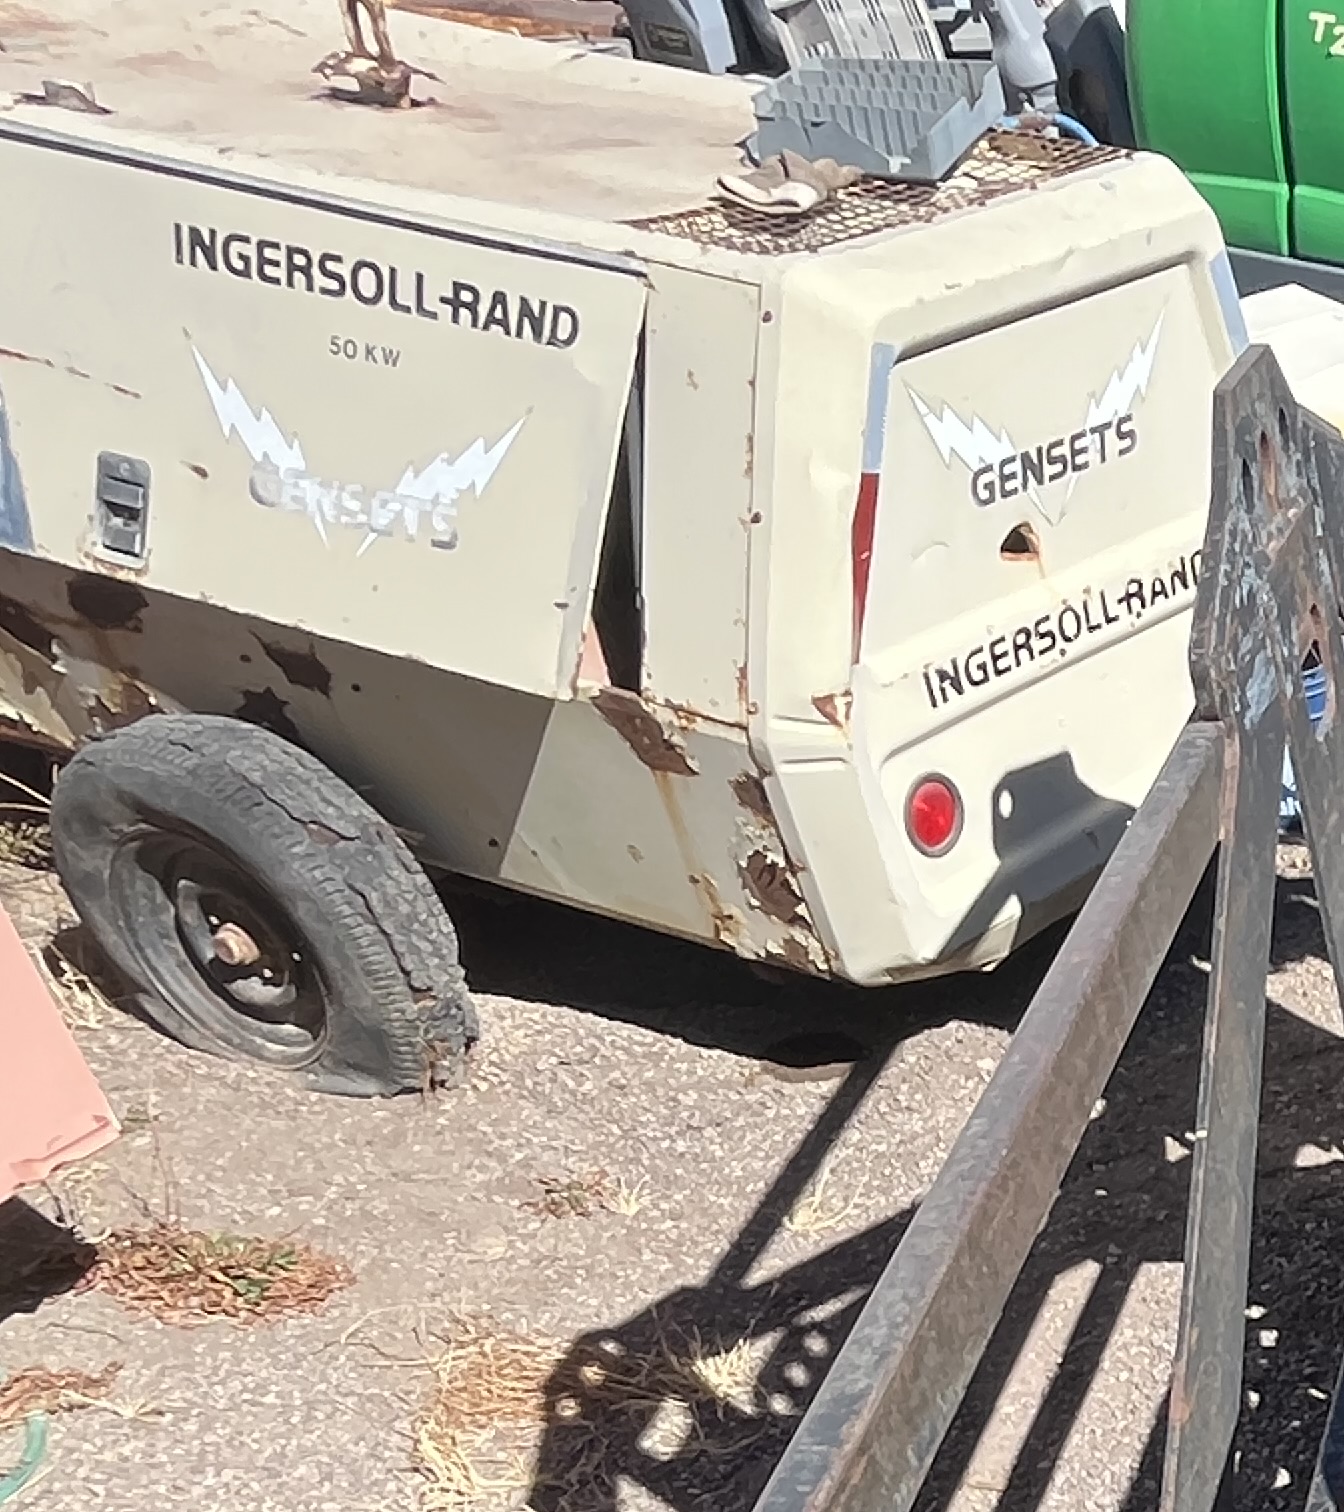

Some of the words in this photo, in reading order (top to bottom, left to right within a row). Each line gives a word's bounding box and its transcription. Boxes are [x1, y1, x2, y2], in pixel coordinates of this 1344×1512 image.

[173, 222, 580, 349] INGERSOLL-RAND
[329, 335, 358, 361] 50
[971, 413, 1138, 507] GENSETS
